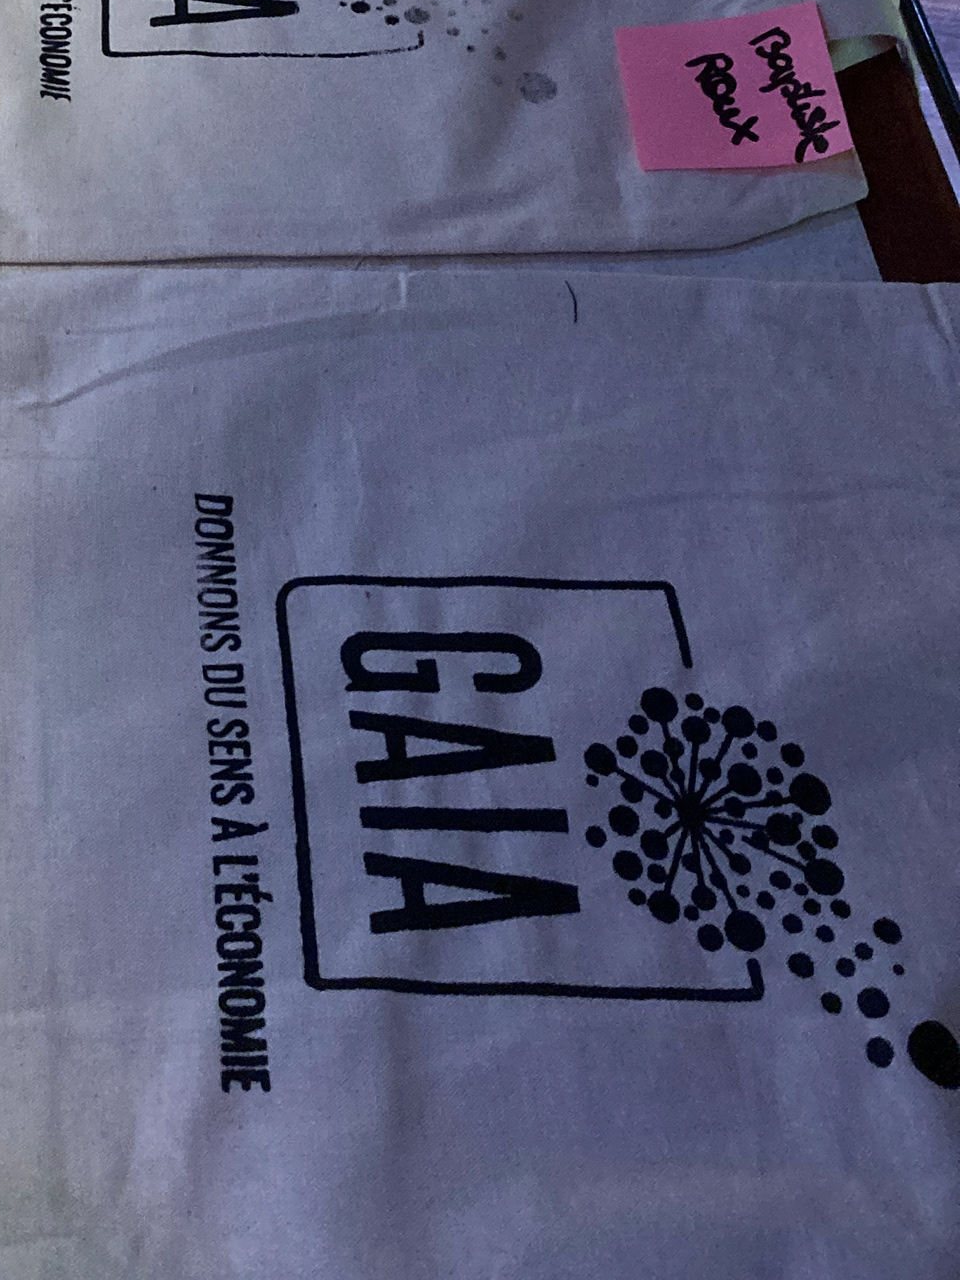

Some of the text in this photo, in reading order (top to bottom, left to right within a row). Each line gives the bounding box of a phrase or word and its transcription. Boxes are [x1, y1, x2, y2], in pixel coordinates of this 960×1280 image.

[194, 492, 273, 1094] DONNONS DU SENS À L'ÉCONOMIE
[340, 631, 582, 935] GAIA
